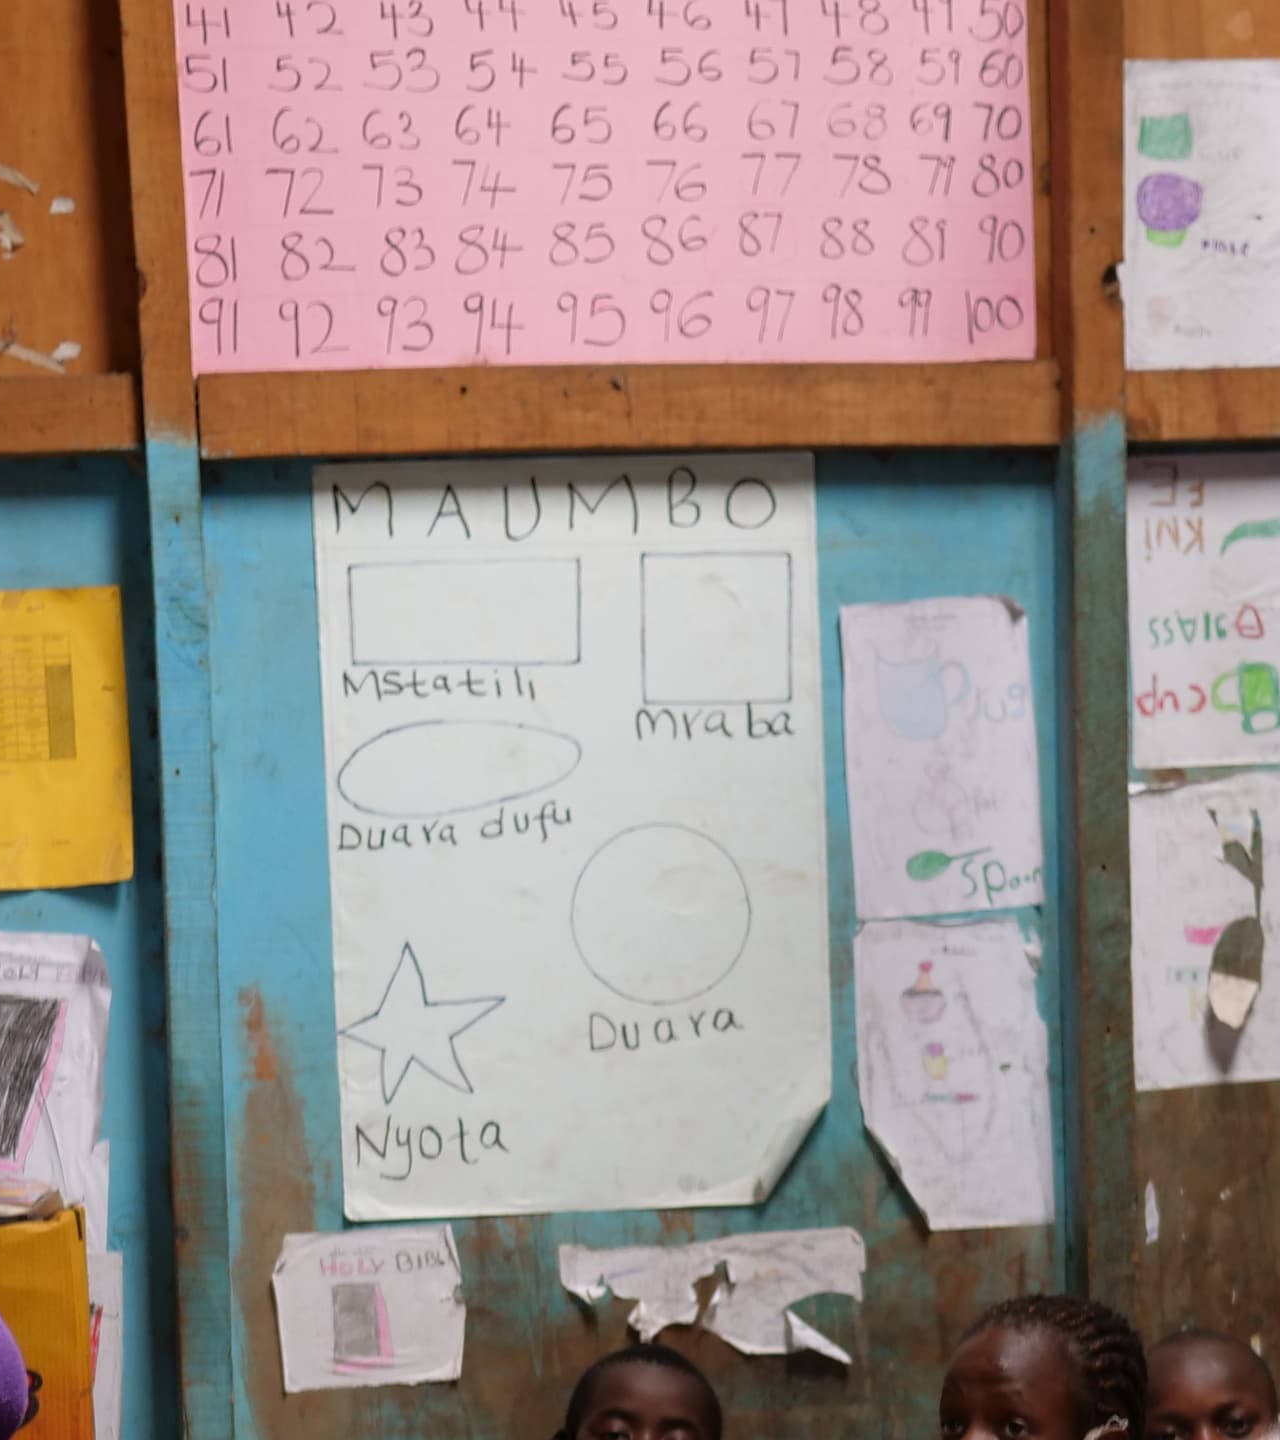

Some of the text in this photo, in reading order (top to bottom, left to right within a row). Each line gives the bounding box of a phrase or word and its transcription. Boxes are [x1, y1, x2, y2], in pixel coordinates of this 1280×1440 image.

[186, 2, 230, 45] 41
[184, 46, 1023, 94] 51 52 53 54 55 56 57 58 59 60
[193, 101, 1022, 157] 61 62 63 64 65 66 67 68 69 70
[189, 152, 1024, 219] 71 72 73 74 75 76 77 78 79 80
[194, 211, 1025, 288] 81 82 83 84 85 86 87 88 89 90
[198, 283, 1024, 359] 91 92 93 94 95 96 97 98 99 100
[332, 466, 778, 542] MAUMBO
[337, 800, 573, 851] Duara dufu
[588, 1006, 744, 1053] Duara
[356, 1115, 510, 1181] Nyota
